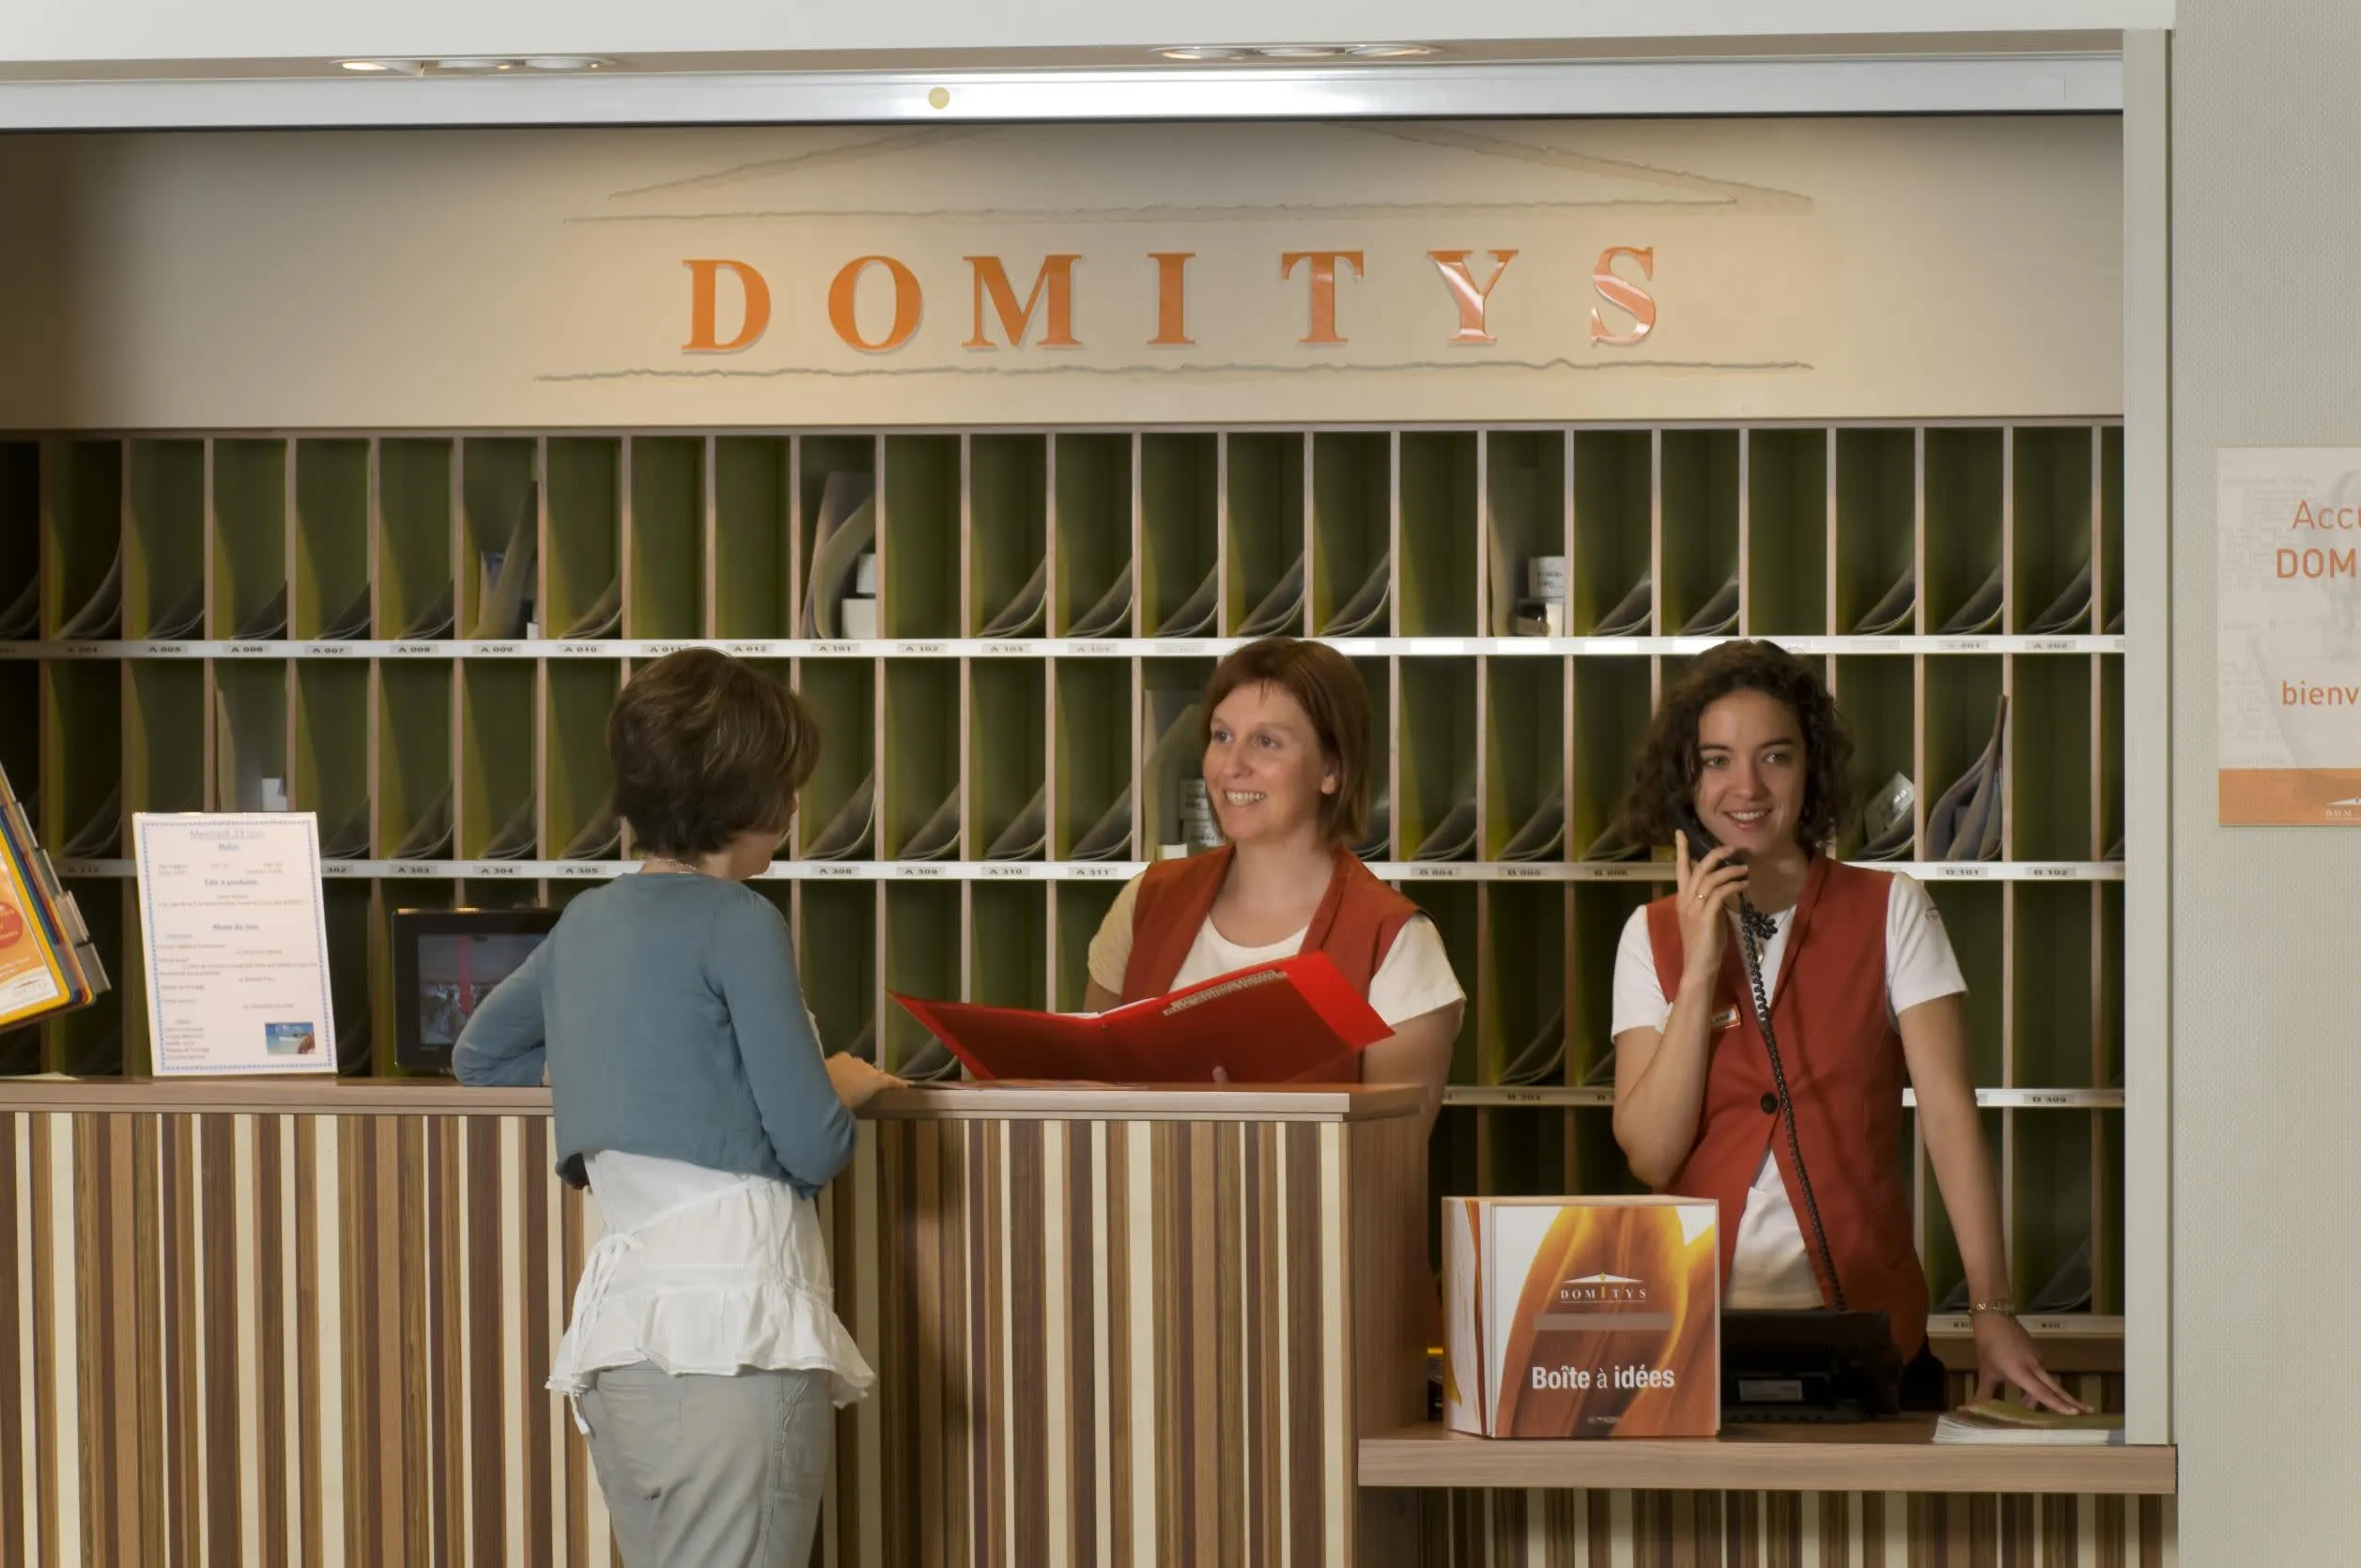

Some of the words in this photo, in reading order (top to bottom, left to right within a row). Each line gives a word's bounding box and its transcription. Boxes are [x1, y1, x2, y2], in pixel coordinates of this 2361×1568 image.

[682, 246, 1657, 351] DOMITYS
[2276, 547, 2357, 578] DOM
[2281, 680, 2359, 705] bienv
[1560, 1284, 1646, 1299] DOMITYS
[1532, 1364, 1591, 1390] Boîte
[1597, 1367, 1608, 1389] à
[1614, 1363, 1675, 1389] idées
